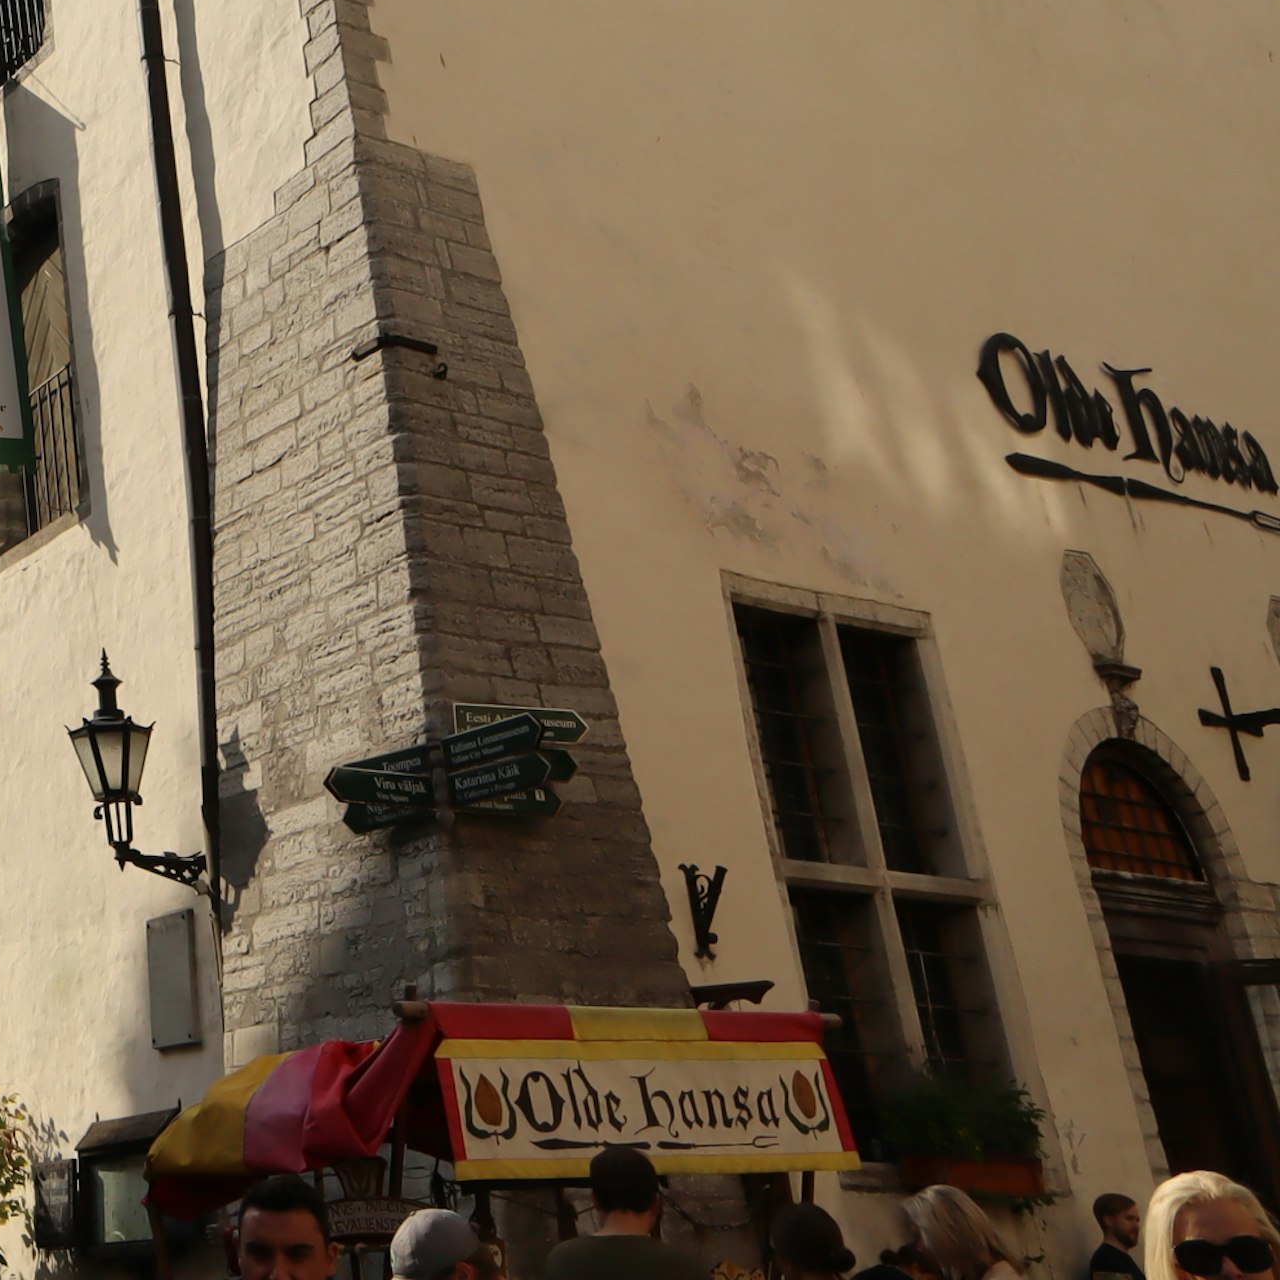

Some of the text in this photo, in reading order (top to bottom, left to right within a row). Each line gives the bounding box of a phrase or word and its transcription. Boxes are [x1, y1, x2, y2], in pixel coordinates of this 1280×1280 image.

[976, 332, 1120, 452] Olde
[382, 756, 422, 772] Toompea
[515, 1060, 628, 1133] Olde
